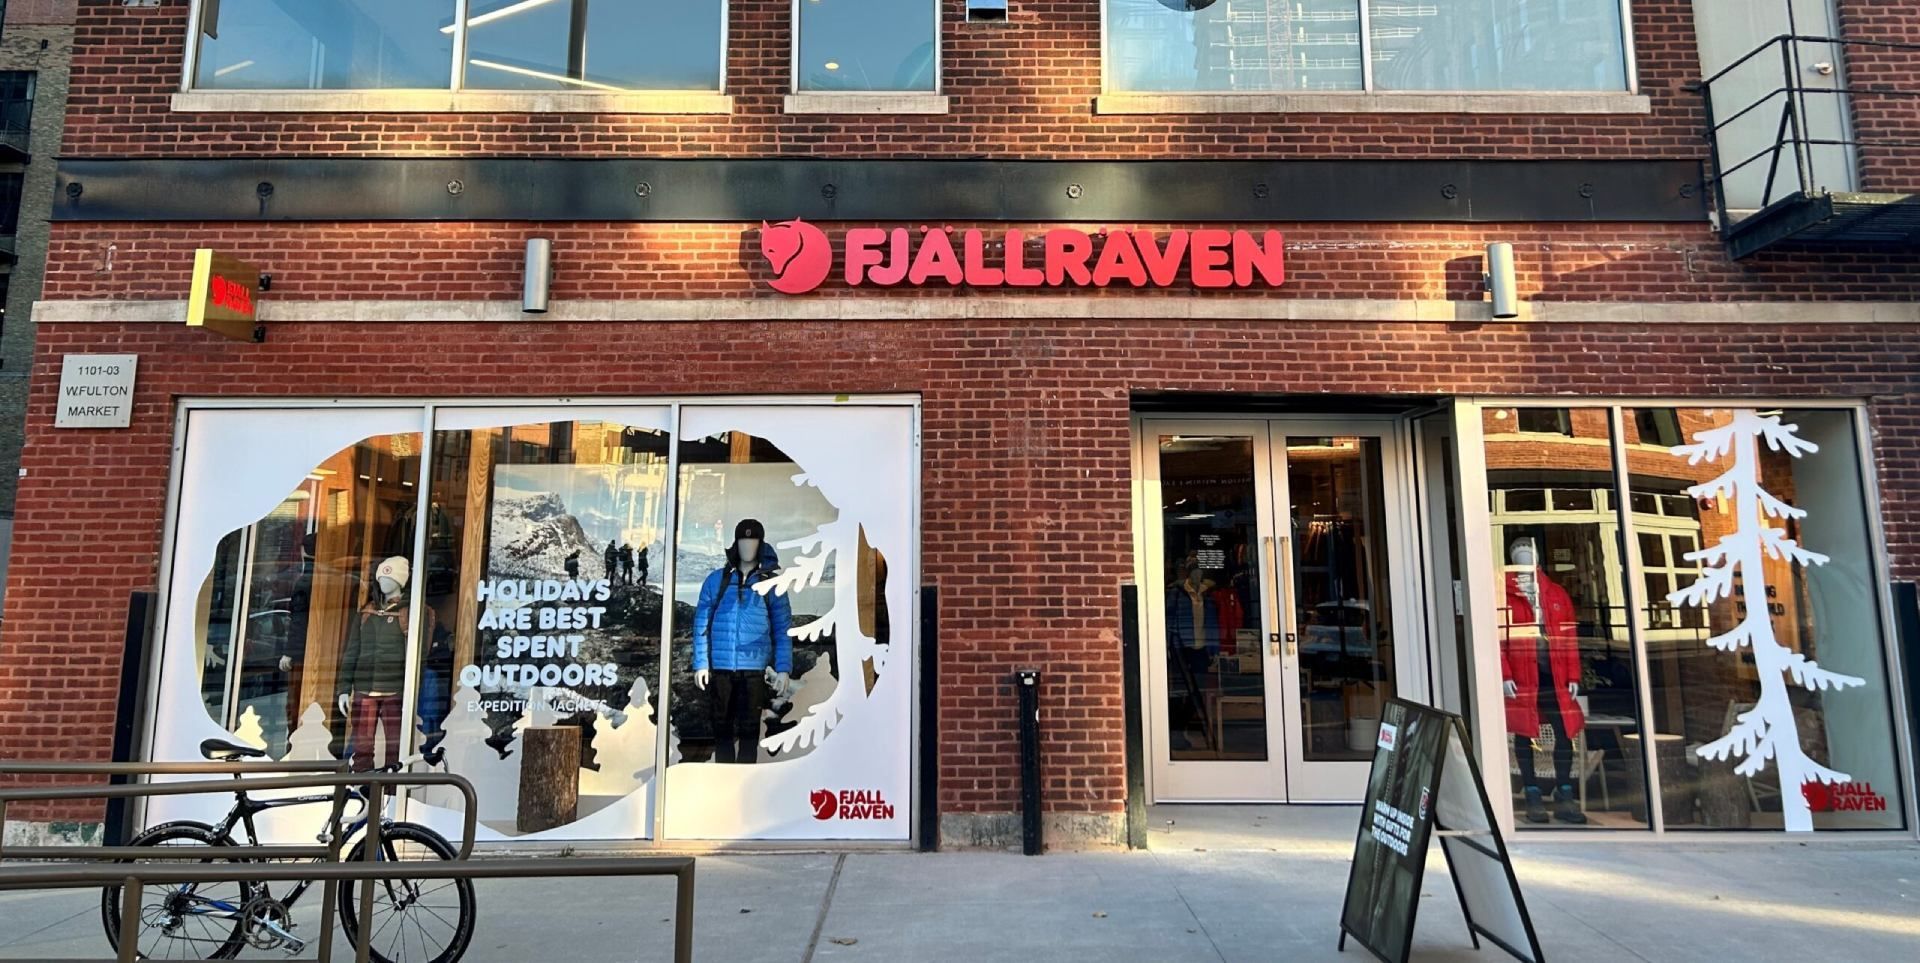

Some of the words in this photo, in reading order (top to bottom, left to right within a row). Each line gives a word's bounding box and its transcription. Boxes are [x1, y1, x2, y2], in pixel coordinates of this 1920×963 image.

[844, 225, 1286, 288] FJÄLLRÄVEN
[78, 366, 120, 375] 1101-03
[68, 406, 120, 416] MARKET
[477, 579, 611, 602] HOLIDAYS
[478, 608, 532, 630] ARE
[539, 607, 606, 630] BEST
[496, 635, 585, 659] SPENT
[459, 663, 618, 687] OUTDOORS
[467, 700, 545, 712] EXPEDITION
